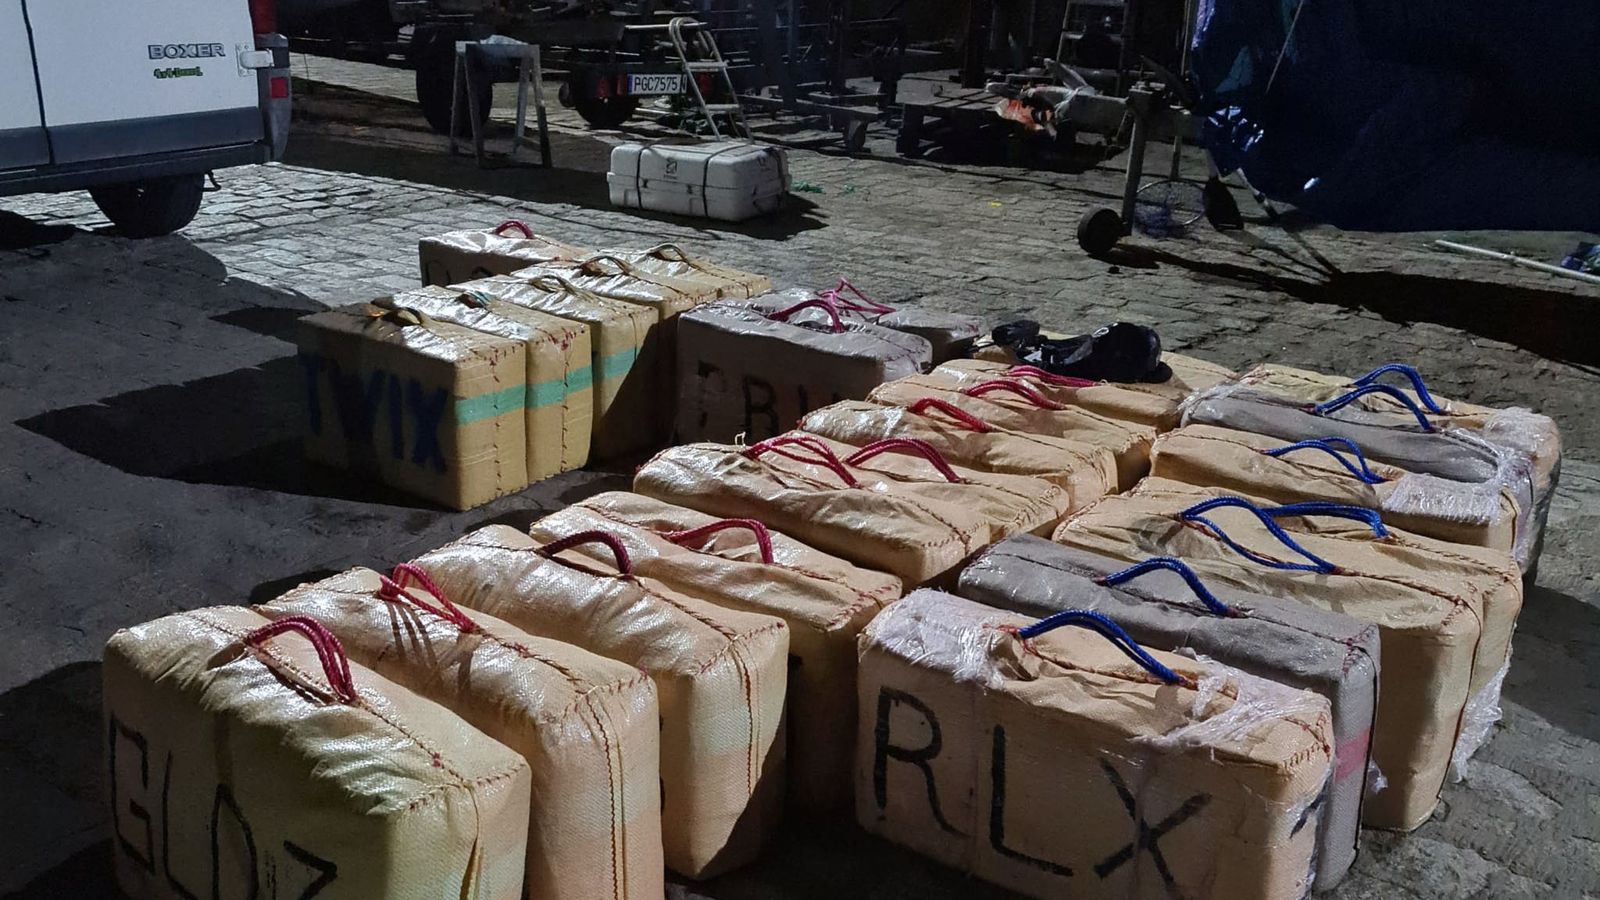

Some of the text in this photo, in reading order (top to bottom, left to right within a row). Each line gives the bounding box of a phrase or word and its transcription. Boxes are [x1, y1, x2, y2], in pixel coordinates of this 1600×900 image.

[148, 43, 225, 59] BOXER
[299, 353, 449, 474] TWIX
[873, 686, 1213, 900] RLX
